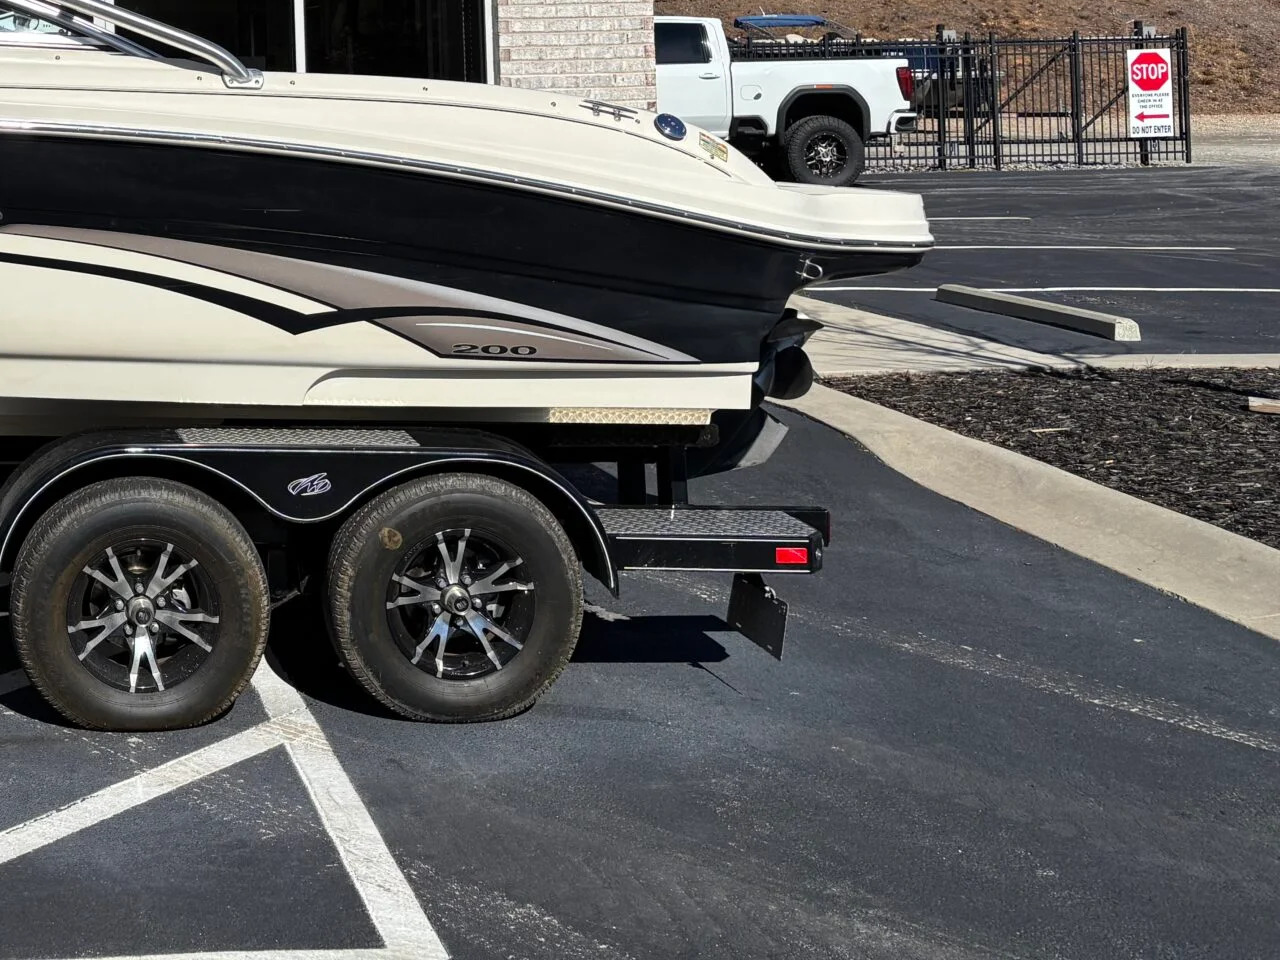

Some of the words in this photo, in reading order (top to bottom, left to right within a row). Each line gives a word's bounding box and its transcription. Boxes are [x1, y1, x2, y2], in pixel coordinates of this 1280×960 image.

[1132, 63, 1168, 80] STOP
[1132, 126, 1140, 134] DO
[1141, 126, 1152, 134] NOT
[1153, 125, 1172, 134] ENTER
[452, 343, 538, 357] 200
